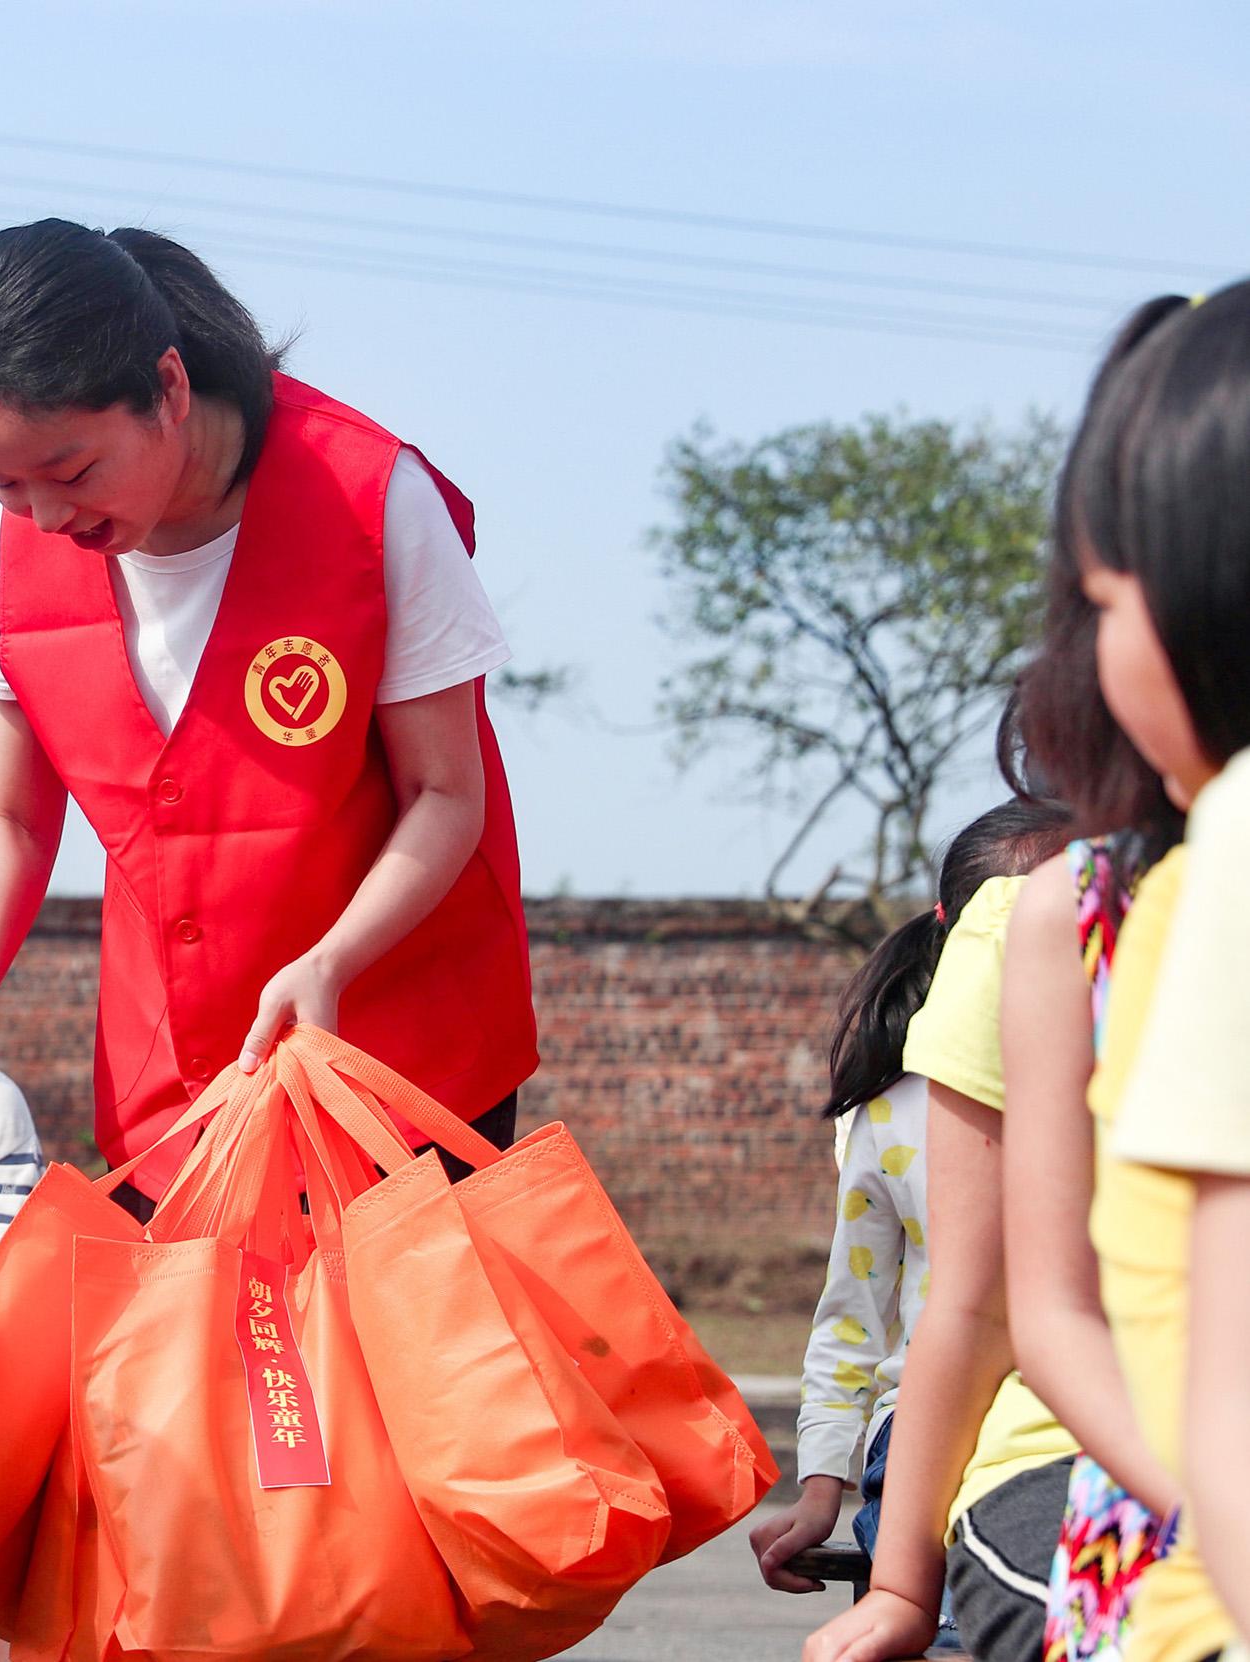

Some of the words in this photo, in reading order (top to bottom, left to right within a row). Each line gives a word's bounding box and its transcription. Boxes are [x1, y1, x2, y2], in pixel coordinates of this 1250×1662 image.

[252, 639, 331, 675] 青年志愿者
